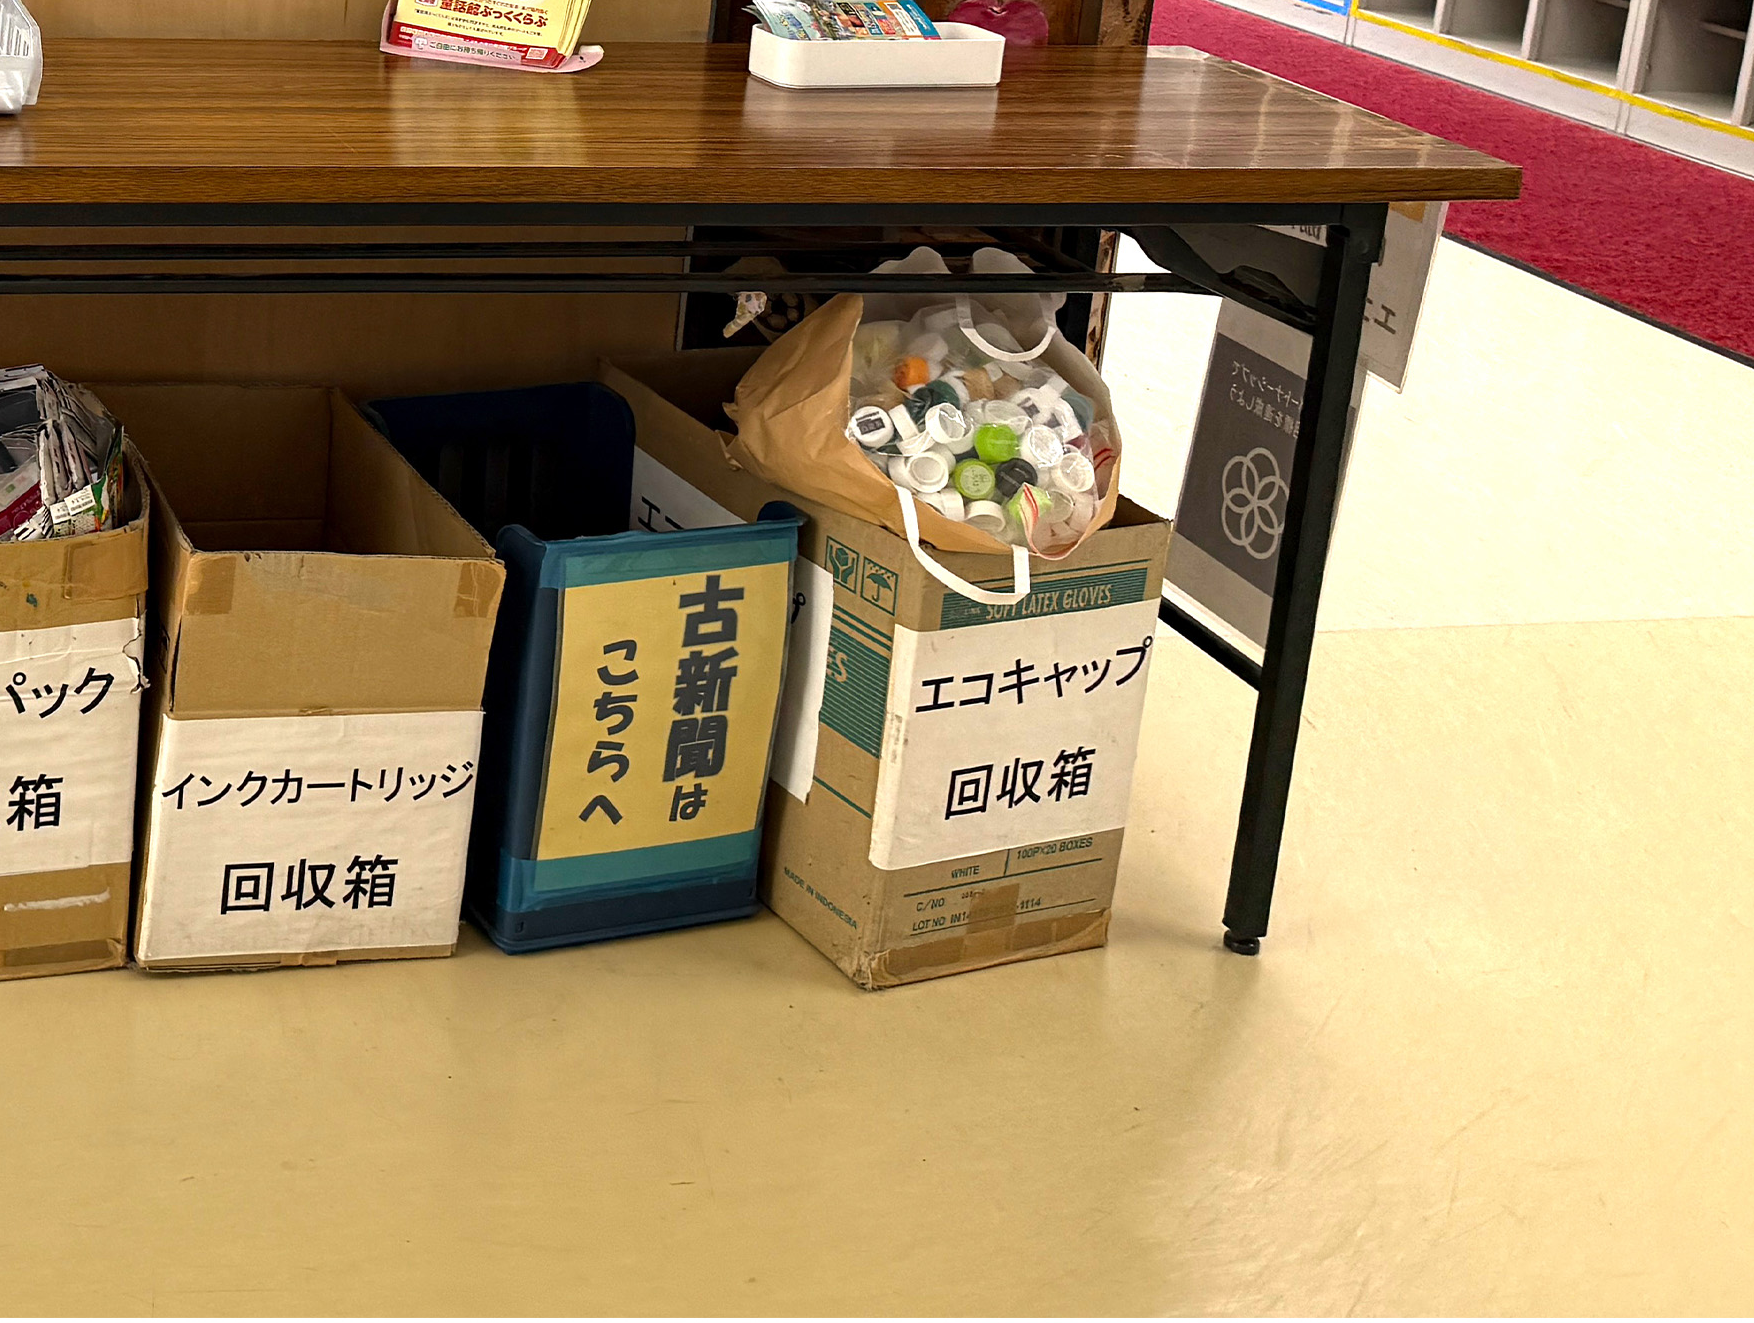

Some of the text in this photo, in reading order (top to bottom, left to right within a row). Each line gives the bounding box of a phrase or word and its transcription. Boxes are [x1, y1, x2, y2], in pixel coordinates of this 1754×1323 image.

[1021, 591, 1059, 616] LATEX
[1062, 584, 1113, 609] GLOVES
[662, 574, 745, 823] 古新聞は
[915, 635, 1153, 714] エコキャップ
[578, 639, 640, 826] こちらへ
[161, 760, 475, 810] インクカートリッジ
[944, 745, 1096, 821] 回収箱
[951, 865, 980, 880] WHITE
[1058, 837, 1093, 853] BOXES
[219, 854, 400, 916] 回収箱
[916, 897, 945, 913] C/NO
